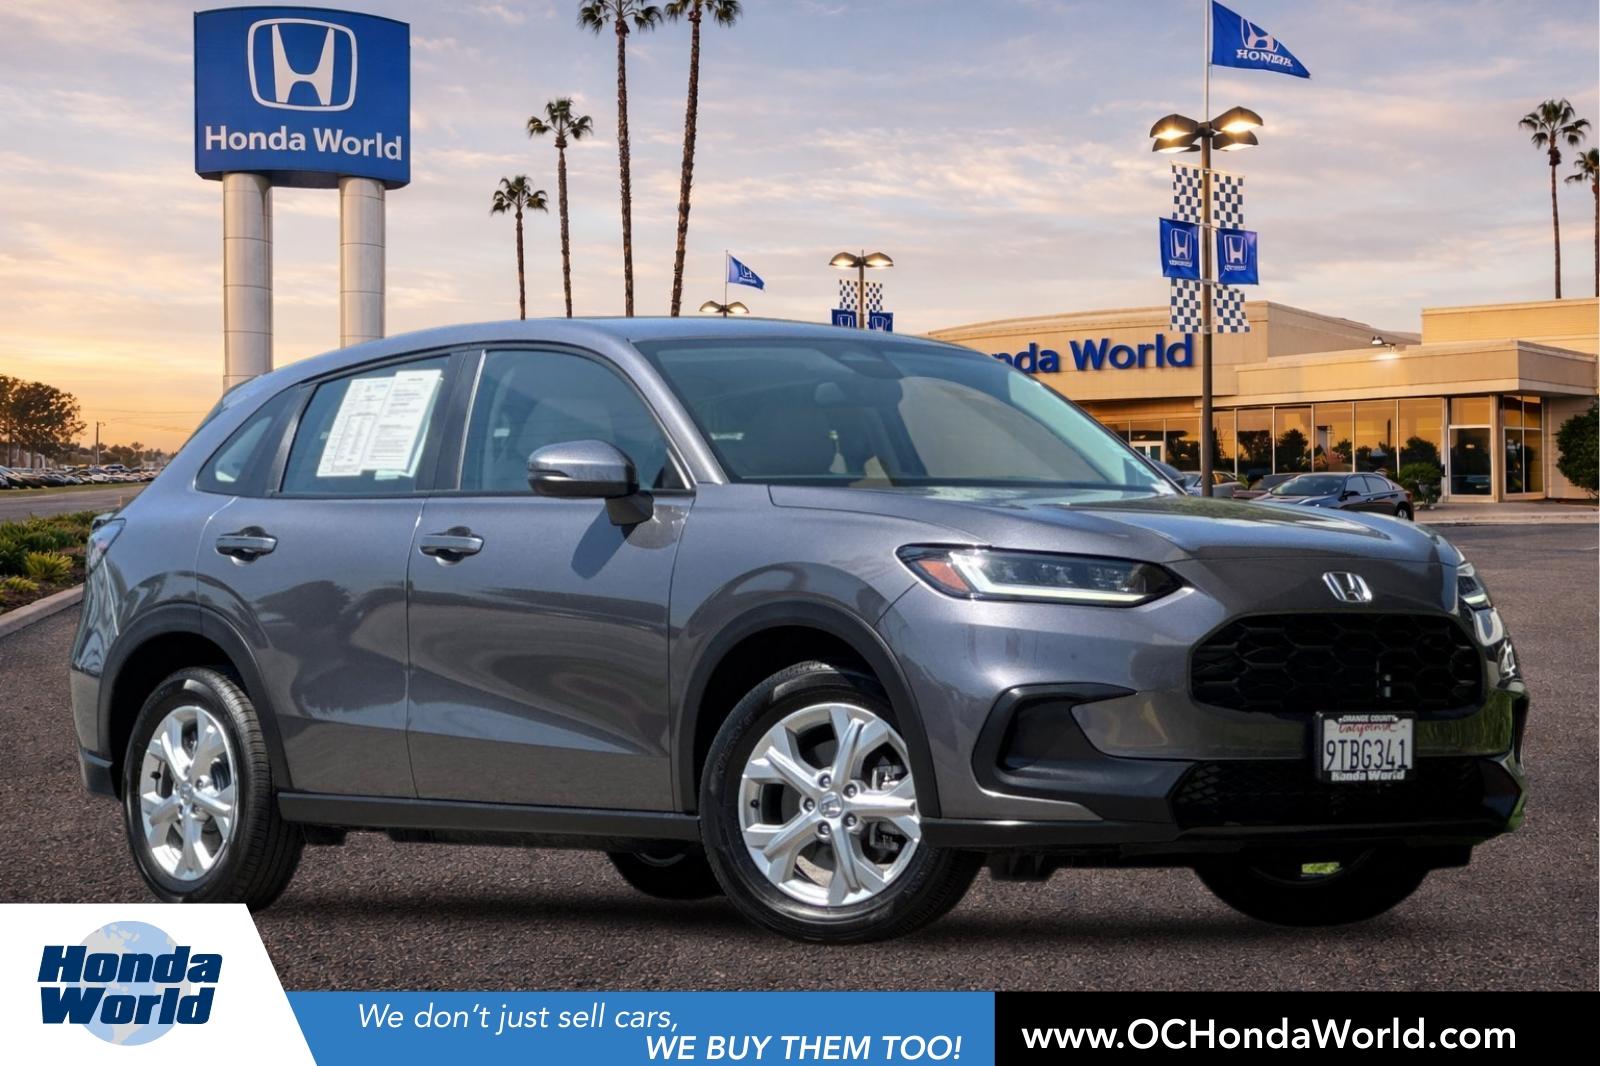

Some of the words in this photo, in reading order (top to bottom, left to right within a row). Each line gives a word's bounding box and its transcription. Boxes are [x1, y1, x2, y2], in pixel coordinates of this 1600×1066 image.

[205, 125, 306, 151] Honda
[313, 127, 402, 161] World
[1069, 333, 1194, 371] World
[1326, 739, 1408, 770] 9TBG341
[1331, 770, 1366, 781] Honda
[1368, 769, 1405, 780] World
